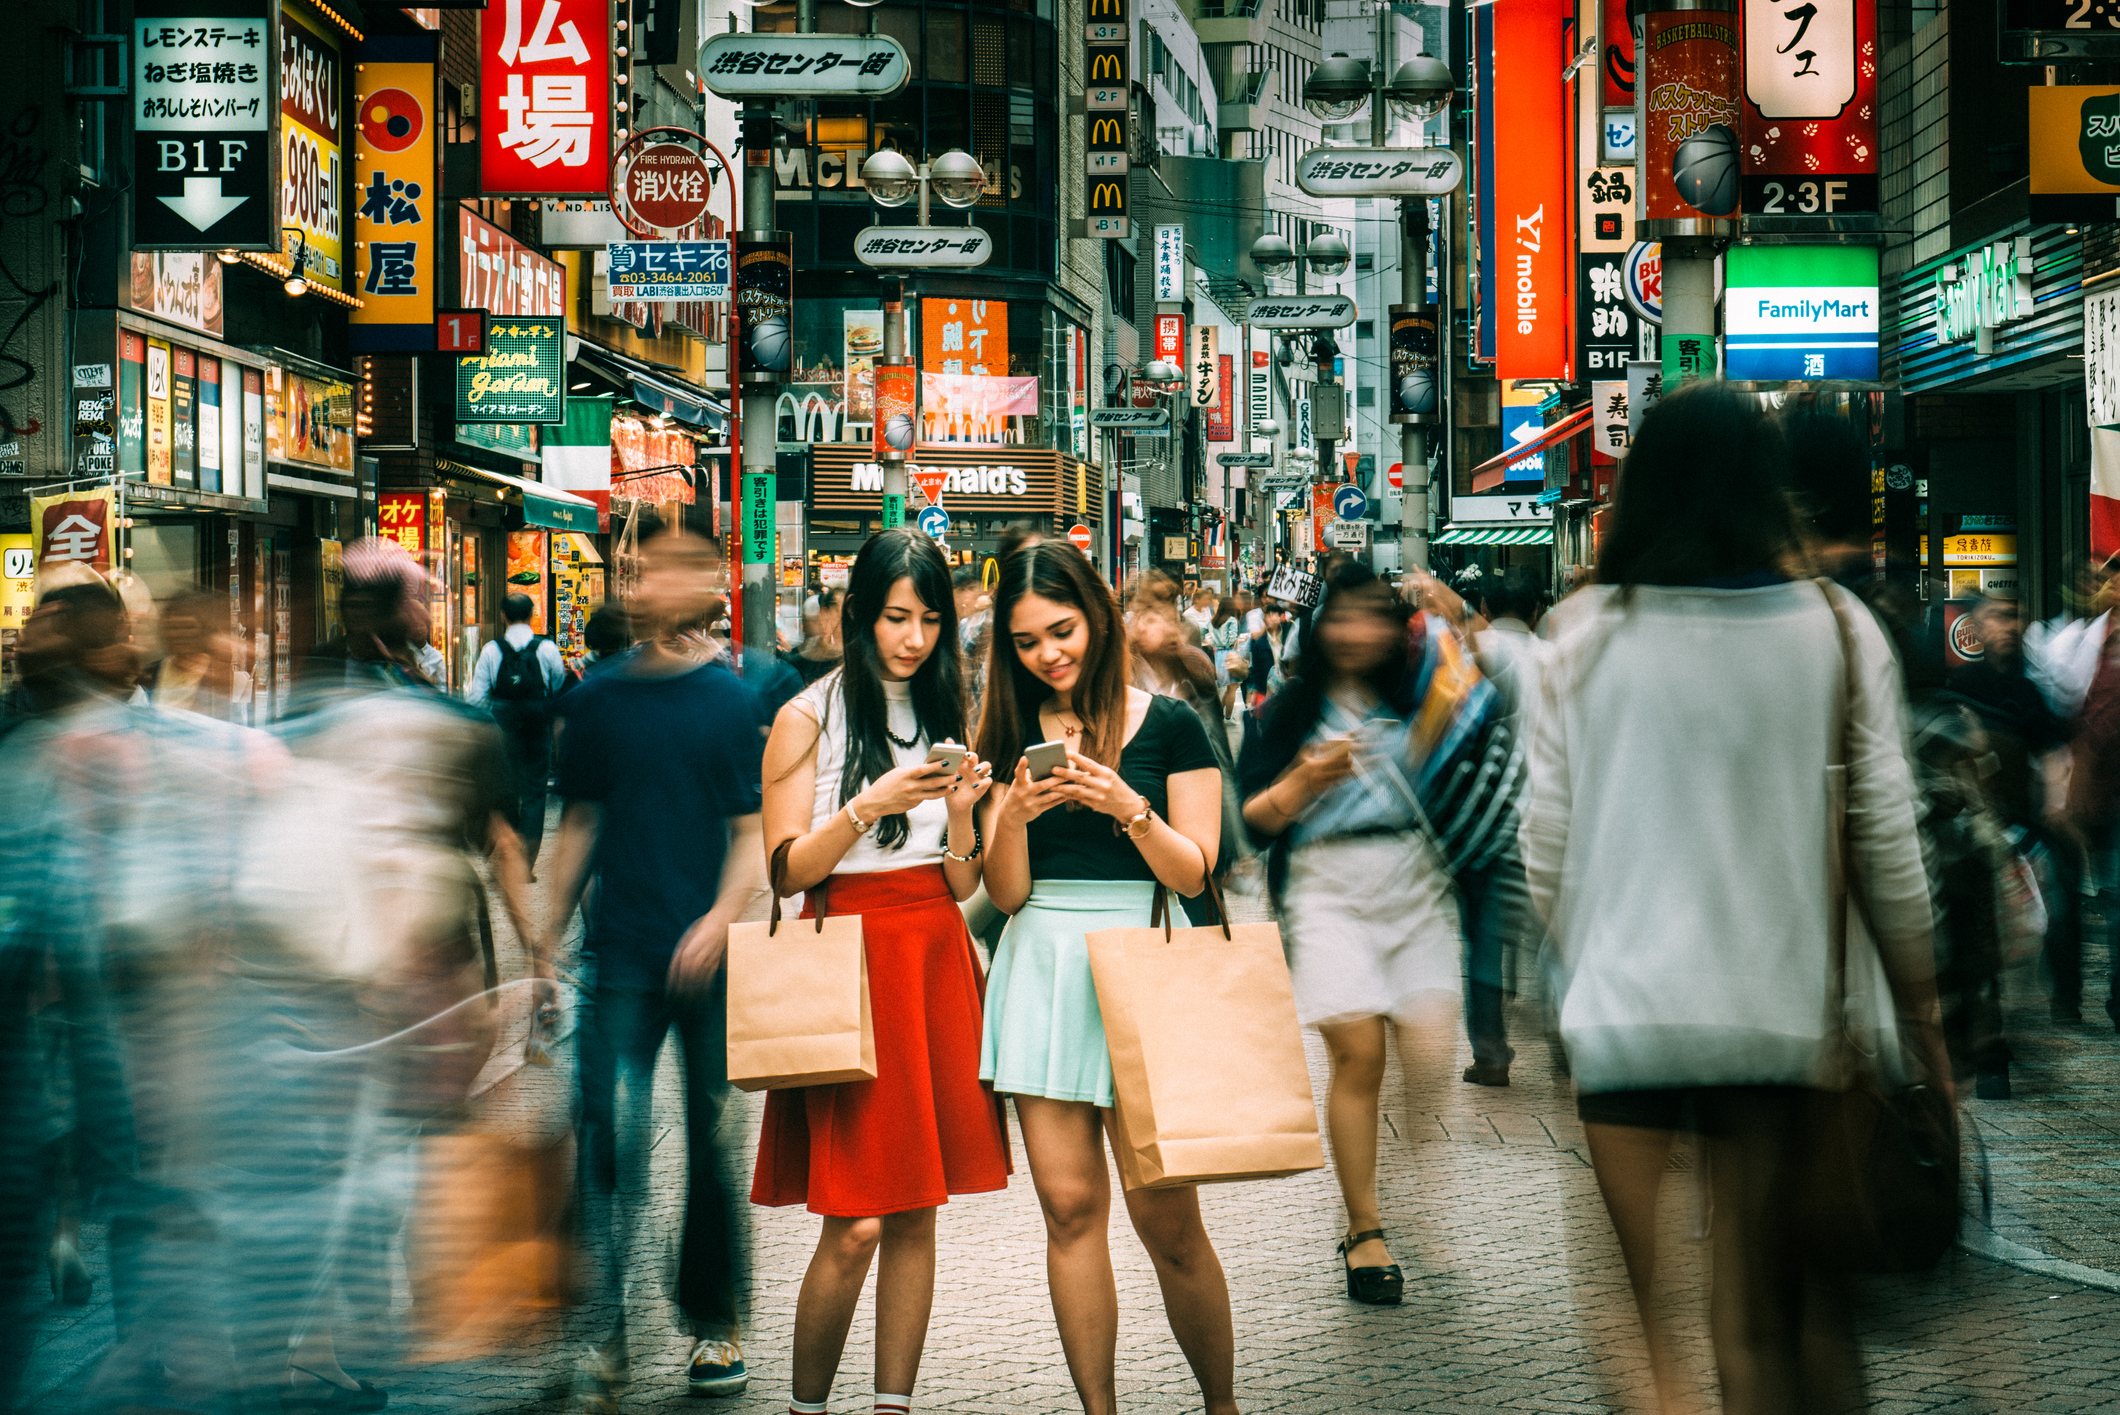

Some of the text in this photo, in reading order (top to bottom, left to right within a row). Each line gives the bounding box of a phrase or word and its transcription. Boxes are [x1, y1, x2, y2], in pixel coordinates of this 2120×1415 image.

[143, 28, 260, 48] レモンステーキ
[1098, 27, 1118, 38] 3F
[1656, 23, 1713, 51] BASKETBALL
[144, 62, 259, 84] ねぎ塩焼き
[708, 52, 894, 76] 渋谷センター街
[1098, 91, 1118, 102] 2F
[143, 98, 260, 119] おろししそハンバーグ
[1606, 124, 1634, 147] セン
[1668, 113, 1732, 141] ストリート
[157, 140, 248, 172] B1F
[640, 155, 697, 165] FIRE HYDRANT
[1099, 156, 1118, 167] 1F
[1307, 161, 1453, 180] 渋谷センター街
[634, 170, 705, 202] 消火栓
[1587, 172, 1631, 204] 鍋
[547, 204, 622, 212] VNDLISM
[360, 171, 422, 296] 松屋
[1099, 219, 1120, 231] B1
[862, 238, 983, 255] 渋谷センター街
[639, 244, 727, 271] セキネ
[1160, 229, 1171, 299] 日本舞踊教室
[630, 272, 717, 283] 03-3464-2061
[612, 286, 634, 297] 買取
[748, 307, 787, 324] ストリート
[1251, 304, 1348, 319] 渋谷センター街
[1758, 300, 1869, 322] FamilyMart
[449, 320, 478, 348] 1F
[1399, 362, 1431, 376] ストリート
[1588, 352, 1629, 368] B1F
[1804, 354, 1824, 377] 酒
[1195, 361, 1215, 405] 牛タン
[78, 400, 104, 411] REKA
[470, 405, 546, 414] マイアミガーデン
[78, 411, 104, 421] REKA
[1094, 412, 1161, 422] 渋谷センター街
[1300, 402, 1310, 448] GRAND
[1606, 393, 1630, 448] 寿司
[88, 457, 112, 470] POKE
[1221, 455, 1269, 463] 渋谷センター街
[850, 463, 1027, 495] Mnald's
[920, 478, 943, 486] 止まれ
[379, 499, 421, 523] オケ
[753, 476, 767, 560] 客引きは犯罪です
[45, 514, 102, 562] 全
[1335, 531, 1364, 539] 一方通行
